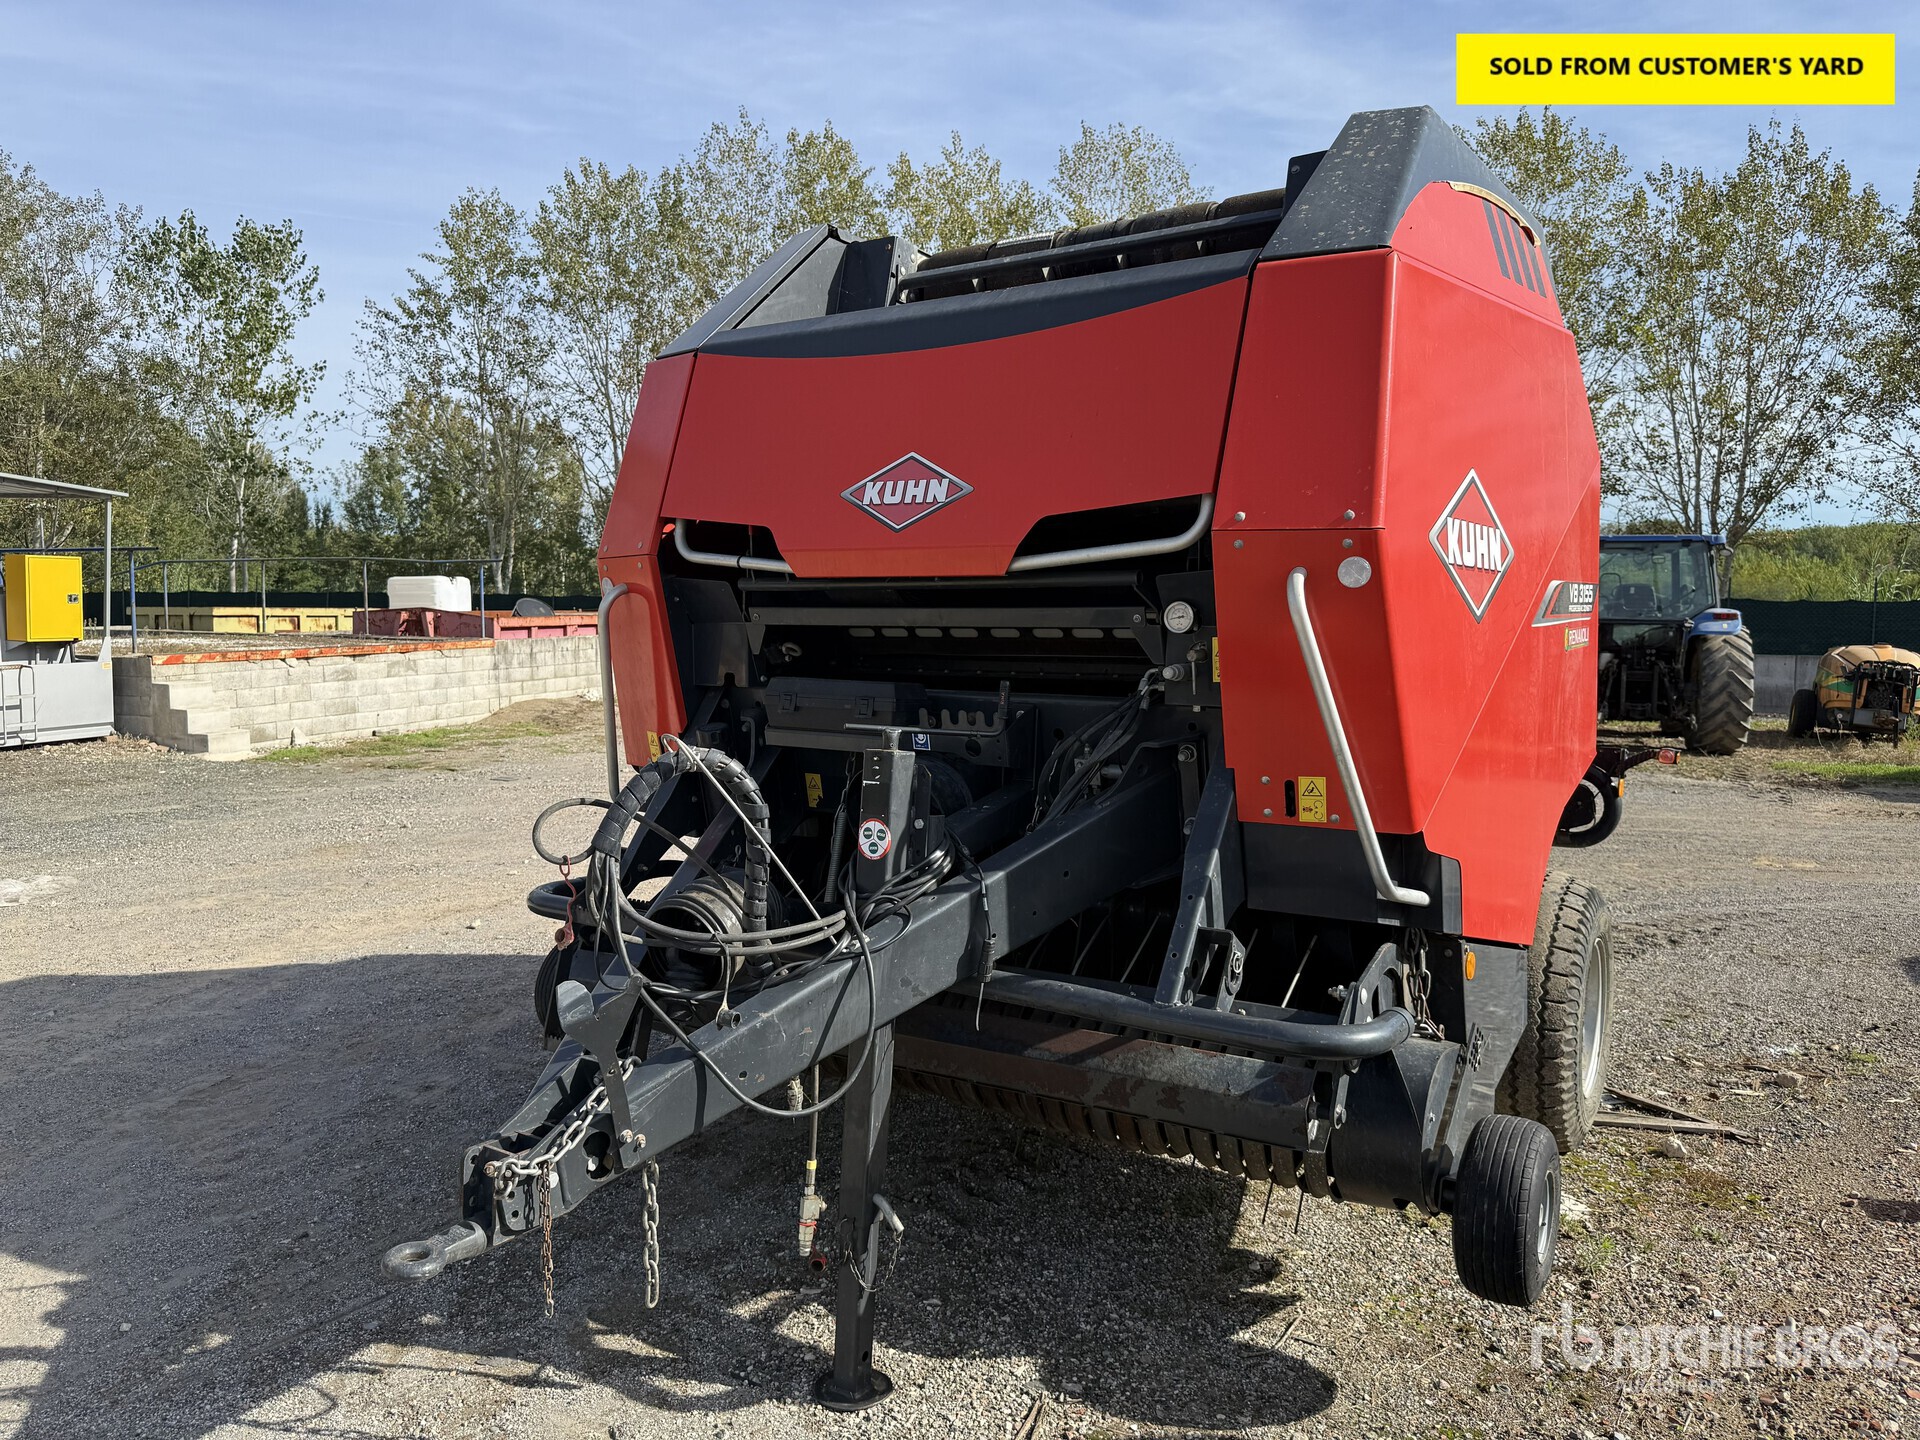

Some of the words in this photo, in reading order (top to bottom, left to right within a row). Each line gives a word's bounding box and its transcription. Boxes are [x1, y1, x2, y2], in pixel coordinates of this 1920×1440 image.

[863, 478, 949, 505] KUHN
[1446, 516, 1502, 573] KUHN
[1569, 583, 1579, 603] VB
